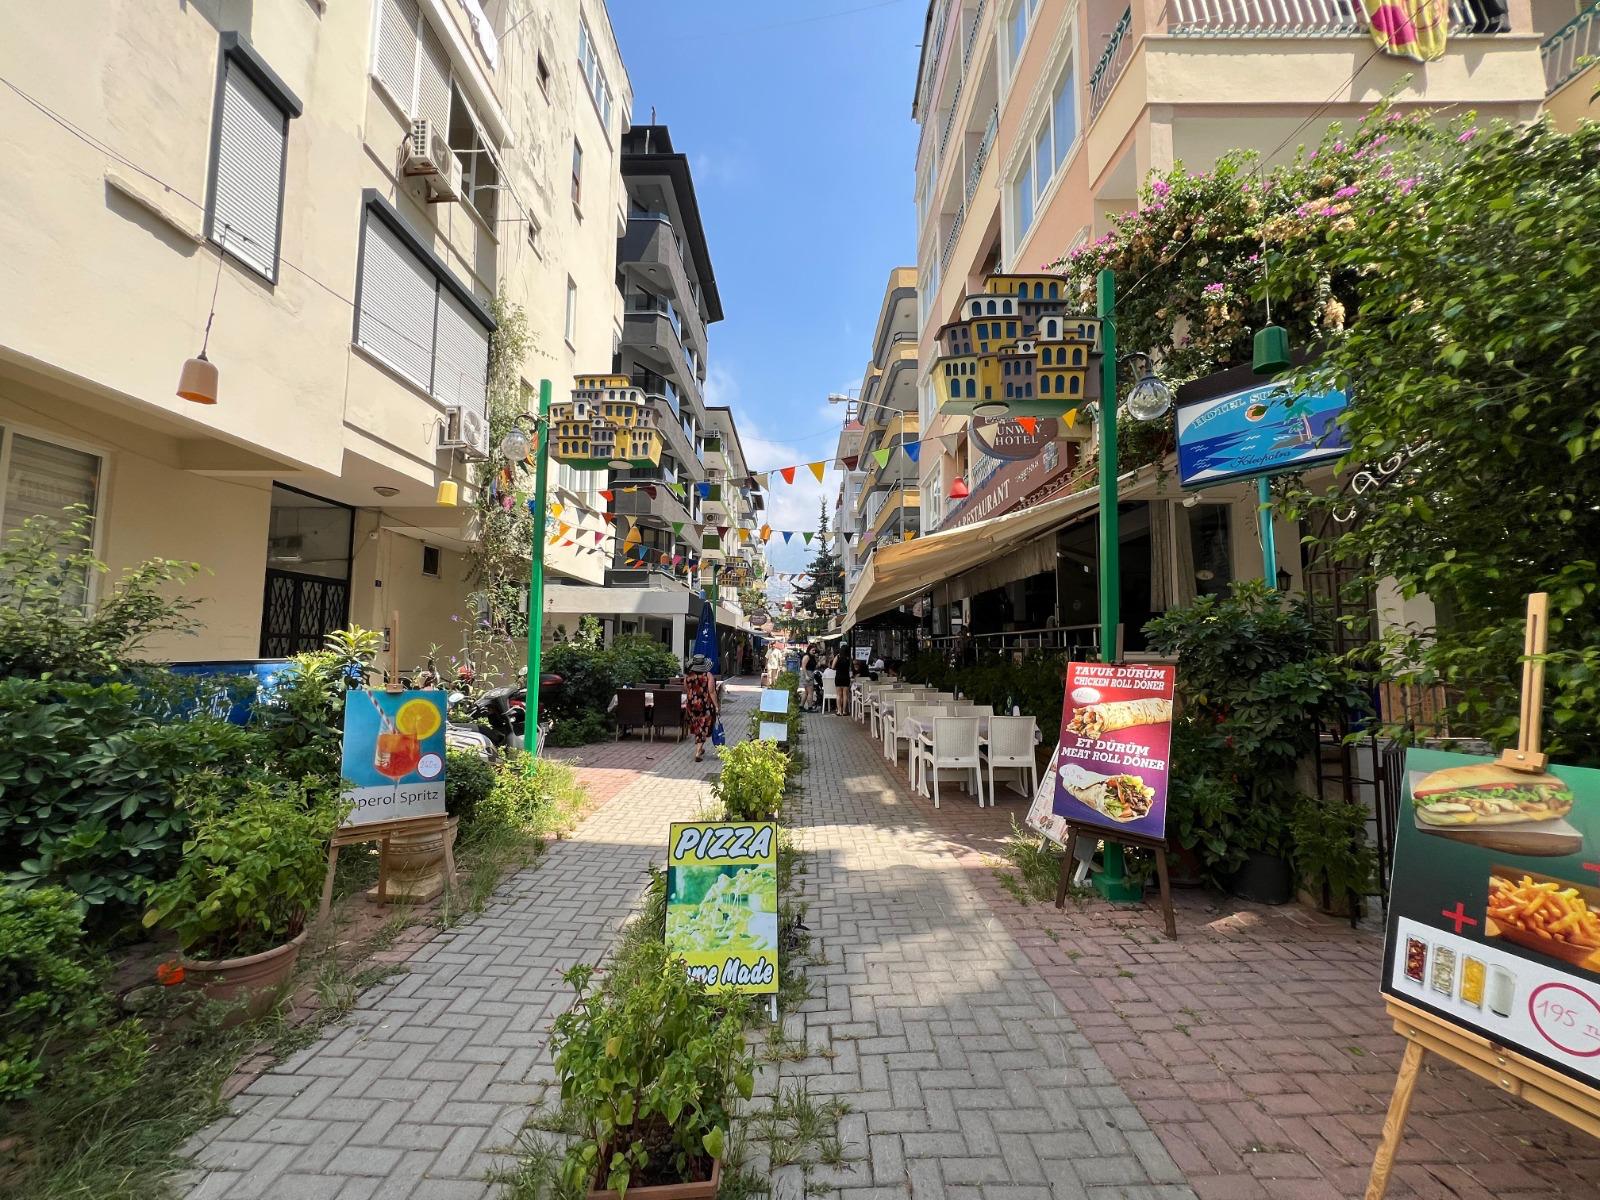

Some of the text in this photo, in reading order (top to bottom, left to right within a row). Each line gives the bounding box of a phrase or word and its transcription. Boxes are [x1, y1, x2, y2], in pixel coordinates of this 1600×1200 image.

[1193, 398, 1247, 429] HOTEL
[995, 435, 1039, 446] HOTEL
[1230, 450, 1291, 469] Kleopatra
[962, 478, 1010, 526] RESTAURANT
[1074, 676, 1109, 687] CHICKEN
[1110, 679, 1132, 689] ROLL
[1075, 666, 1166, 679] TAVUK DÜRÜM
[1075, 737, 1150, 756] ET DÜRÜM
[1061, 747, 1165, 770] MEAT ROLL DÖNER
[400, 789, 439, 806] Spritz
[673, 825, 773, 860] PIZZA
[720, 956, 775, 986] Made
[1537, 1000, 1578, 1027] 195
